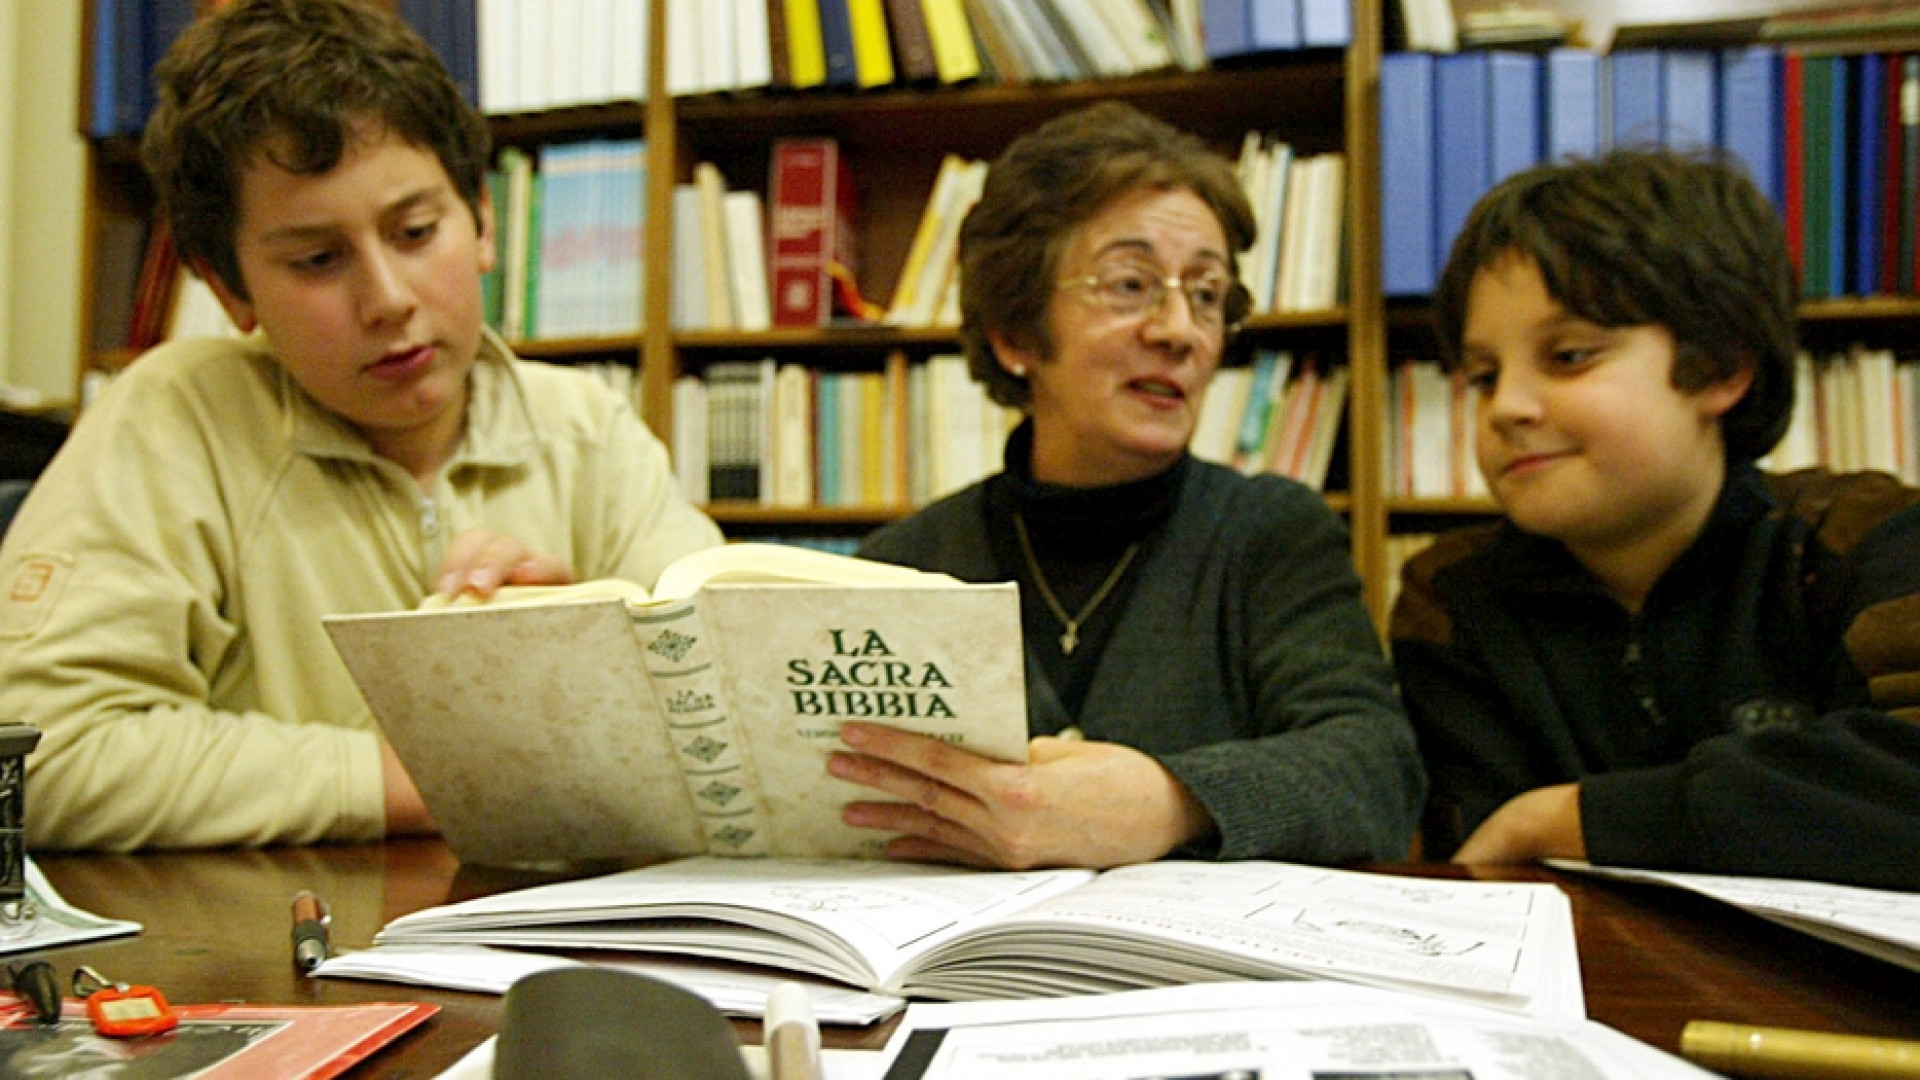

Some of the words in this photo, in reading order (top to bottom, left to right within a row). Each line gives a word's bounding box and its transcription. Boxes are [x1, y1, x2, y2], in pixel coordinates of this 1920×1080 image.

[829, 628, 895, 656] LA
[787, 659, 952, 687] SACRA
[791, 690, 957, 718] BIBBIA
